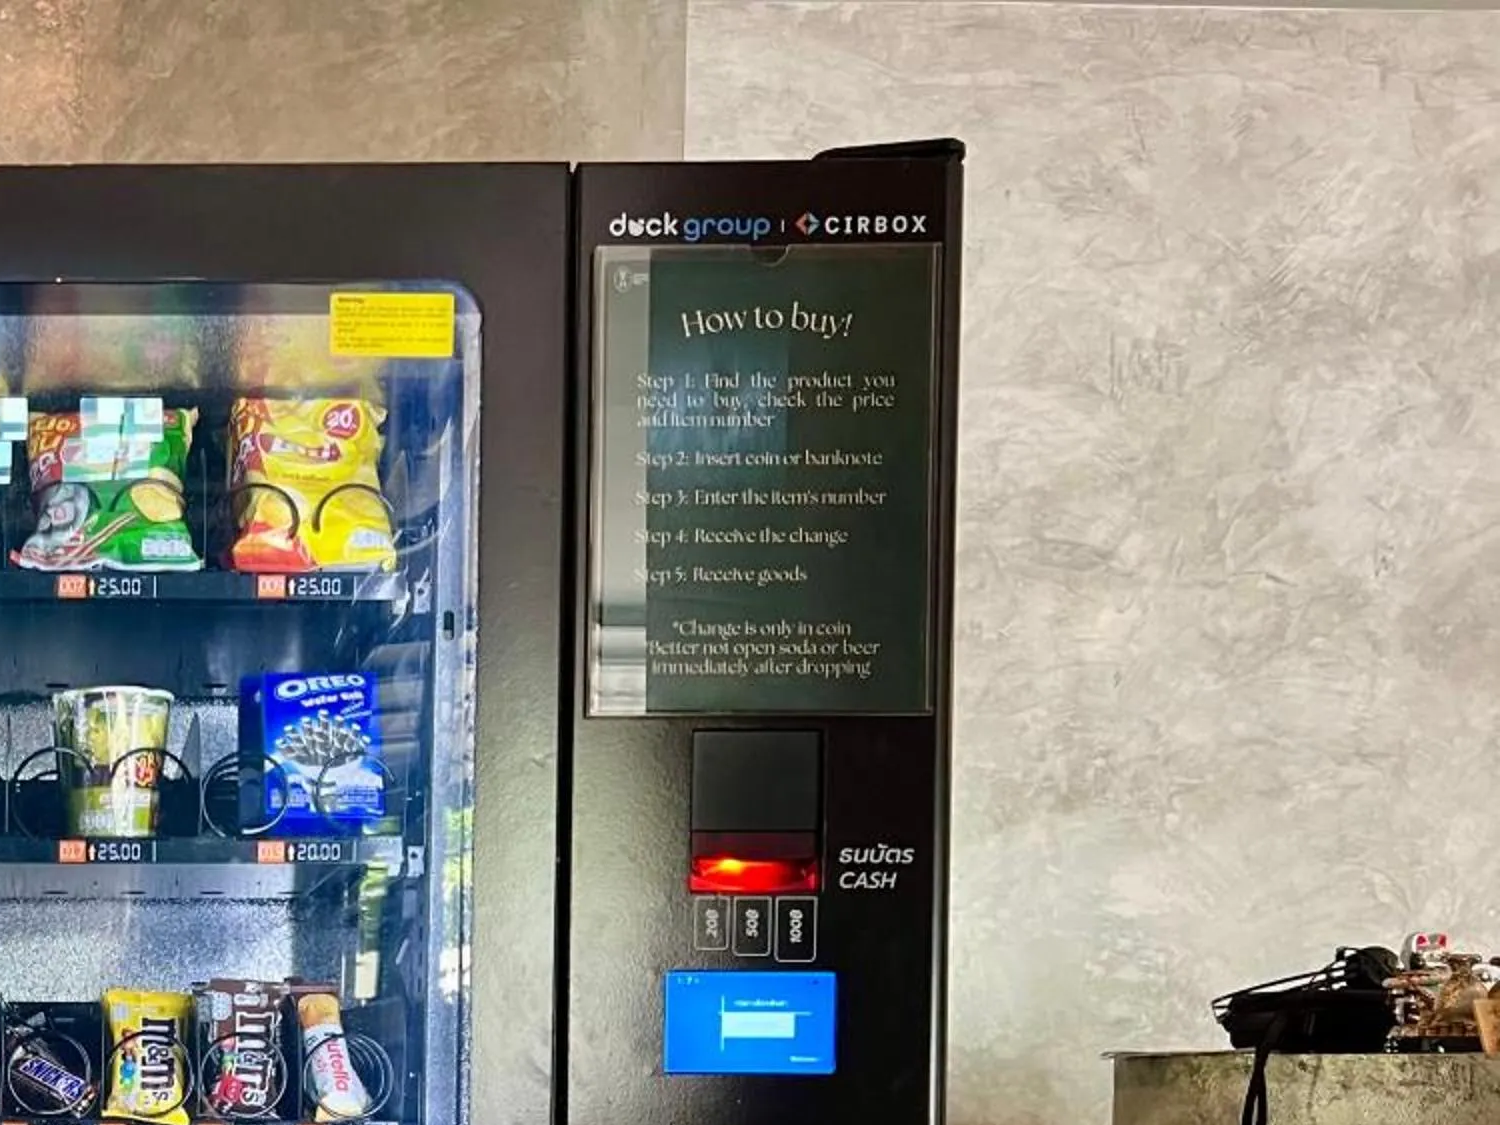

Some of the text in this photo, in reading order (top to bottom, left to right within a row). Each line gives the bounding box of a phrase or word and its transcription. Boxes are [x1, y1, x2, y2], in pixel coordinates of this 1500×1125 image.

[683, 221, 770, 240] group
[825, 215, 927, 233] CIRBOX
[682, 301, 853, 339] How to buy!
[637, 372, 674, 390] Step
[705, 372, 739, 388] Find
[750, 371, 776, 388] the
[788, 371, 850, 391] product
[864, 374, 895, 390] you
[637, 392, 676, 408] need
[688, 395, 704, 407] to
[758, 391, 806, 407] check
[816, 391, 842, 407] the
[853, 393, 894, 411] price
[708, 411, 774, 427] number
[635, 451, 673, 468] Step
[695, 451, 742, 465] Insert
[746, 451, 780, 465] coin
[805, 450, 882, 466] banknote
[695, 489, 738, 506] Enter
[740, 489, 768, 504] the
[821, 489, 887, 506] number
[695, 528, 755, 544] Receive
[760, 527, 786, 543] the
[789, 528, 849, 548] change
[693, 565, 755, 582] Receive
[758, 565, 808, 586] goods
[99, 579, 141, 596] 25.00
[297, 578, 341, 595] 25.00
[745, 620, 756, 635] is
[761, 619, 794, 638] only
[816, 619, 851, 635] coin
[703, 640, 729, 655] not
[734, 641, 775, 658] open
[779, 640, 816, 655] soda
[822, 643, 838, 655] or
[844, 639, 880, 655] beer
[652, 659, 871, 678] immediately after dropping
[276, 674, 366, 699] OREO
[98, 844, 141, 860] 25.00
[297, 844, 341, 861] 20.00
[839, 843, 914, 864] ธนบัตร
[839, 871, 897, 889] CASH
